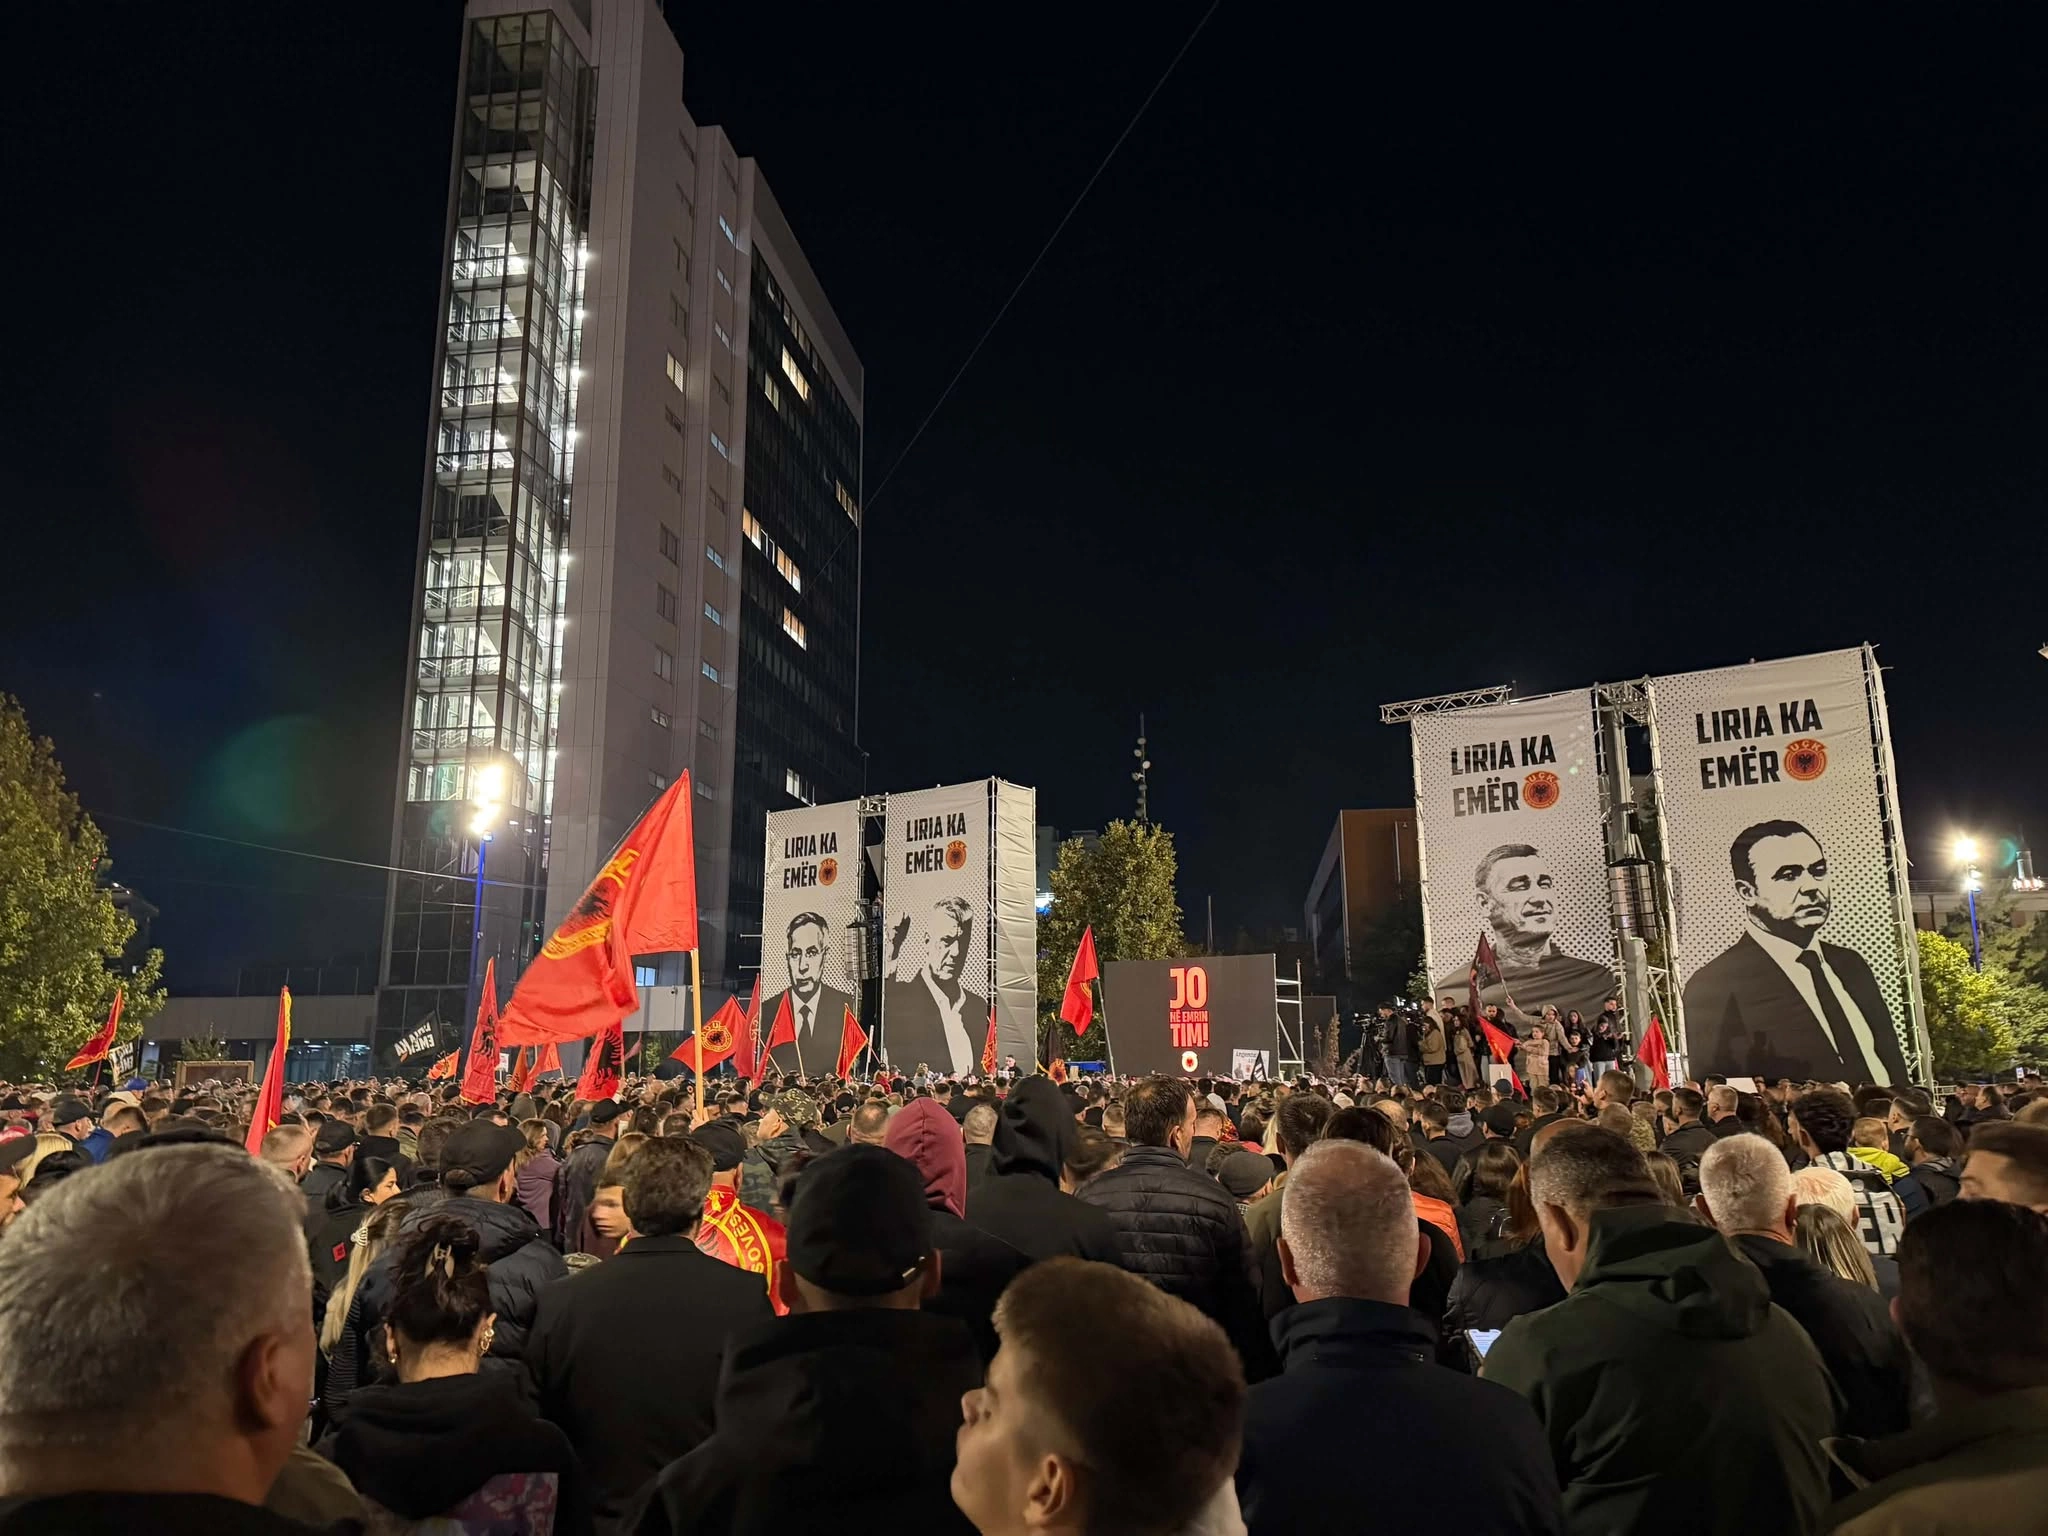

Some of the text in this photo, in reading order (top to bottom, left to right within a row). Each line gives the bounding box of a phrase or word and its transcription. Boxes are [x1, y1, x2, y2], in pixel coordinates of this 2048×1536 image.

[1696, 699, 1823, 744] LIRIA KA
[1451, 735, 1556, 775] LIRIA KA
[1700, 745, 1780, 790] EMËR
[1453, 777, 1519, 817] EMËR
[906, 812, 966, 842] LIRIA KA
[784, 832, 838, 859] LIRIA KA
[906, 844, 943, 874] EMËR
[783, 861, 817, 889] EMËR
[1170, 967, 1207, 1009] JO
[1182, 1010, 1208, 1022] EMRIN
[1170, 1023, 1209, 1047] TIM!
